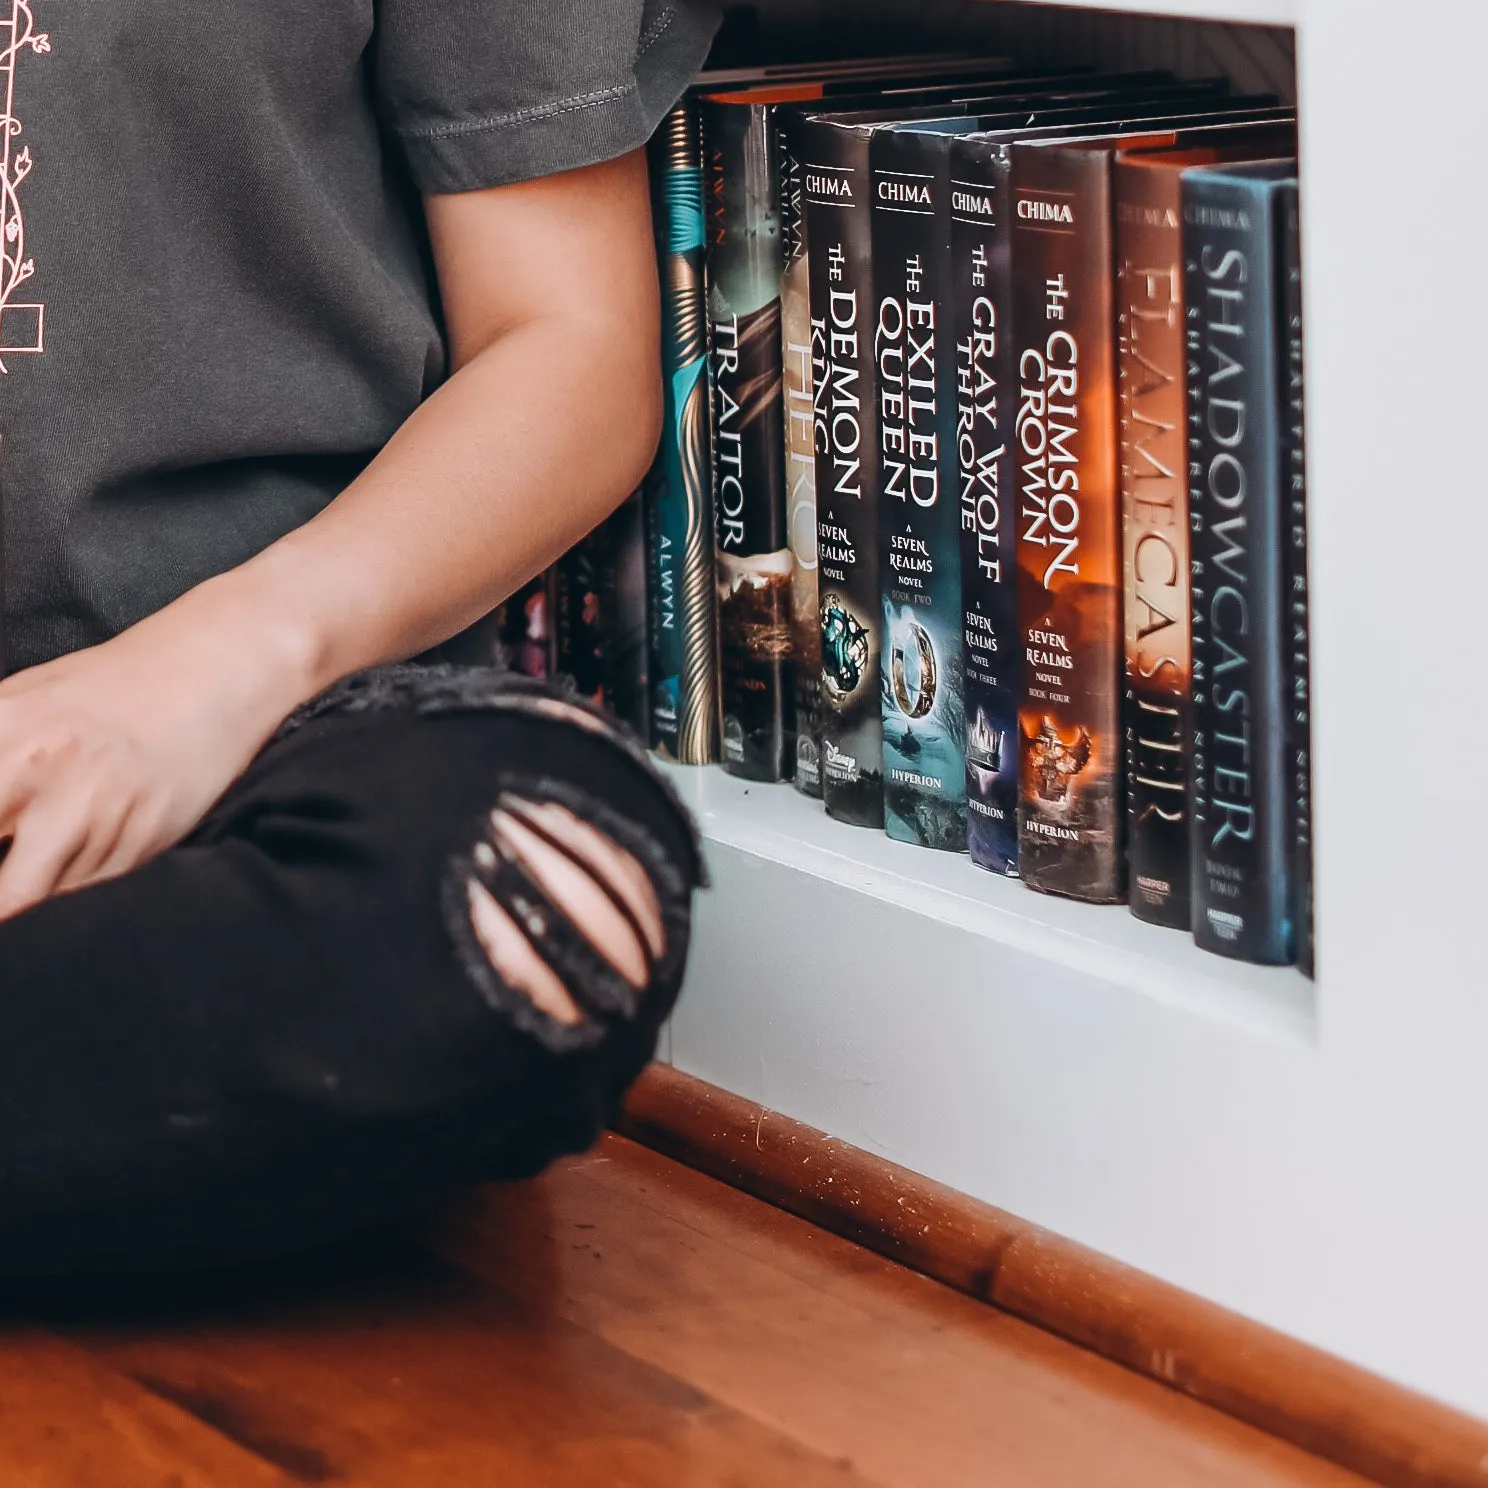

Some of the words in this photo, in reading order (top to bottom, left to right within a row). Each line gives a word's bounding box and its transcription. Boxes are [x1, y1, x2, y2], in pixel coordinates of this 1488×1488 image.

[806, 173, 854, 197] CHIMA
[878, 180, 932, 205] CHIMA
[789, 154, 802, 259] ALWYN
[952, 191, 993, 215] CHIMA
[1017, 200, 1074, 223] CHIMA
[828, 243, 845, 281] THE
[906, 254, 923, 293] THE
[971, 244, 988, 287] THE
[1045, 274, 1069, 320] THE
[972, 296, 997, 430] GRAY
[810, 316, 830, 455] KING
[829, 287, 862, 500] DEMON
[875, 296, 906, 502] QUEEN
[907, 297, 938, 508] EXILED
[715, 313, 744, 550] TRAITOR
[956, 336, 977, 533] THRONE
[1016, 348, 1047, 547] CROWN
[1044, 330, 1080, 590] CRIMSON
[976, 444, 1005, 583] WOLF
[818, 521, 852, 546] SEVEN
[891, 535, 930, 557] SEVEN
[1202, 244, 1255, 846] SHADOWCASTER
[823, 567, 845, 581] NOVEL
[889, 553, 933, 573] REALMS
[660, 534, 674, 629] ALWYN
[898, 575, 923, 588] NOVEL
[966, 612, 995, 635] SEVEN
[965, 630, 998, 652] REALMS
[1028, 629, 1070, 652] SEVEN
[971, 654, 989, 668] NOVEL
[1026, 647, 1074, 669] REALMS
[1035, 672, 1063, 686] NOVEL
[891, 768, 942, 788] HYPERION
[1026, 820, 1079, 841] HYPERION
